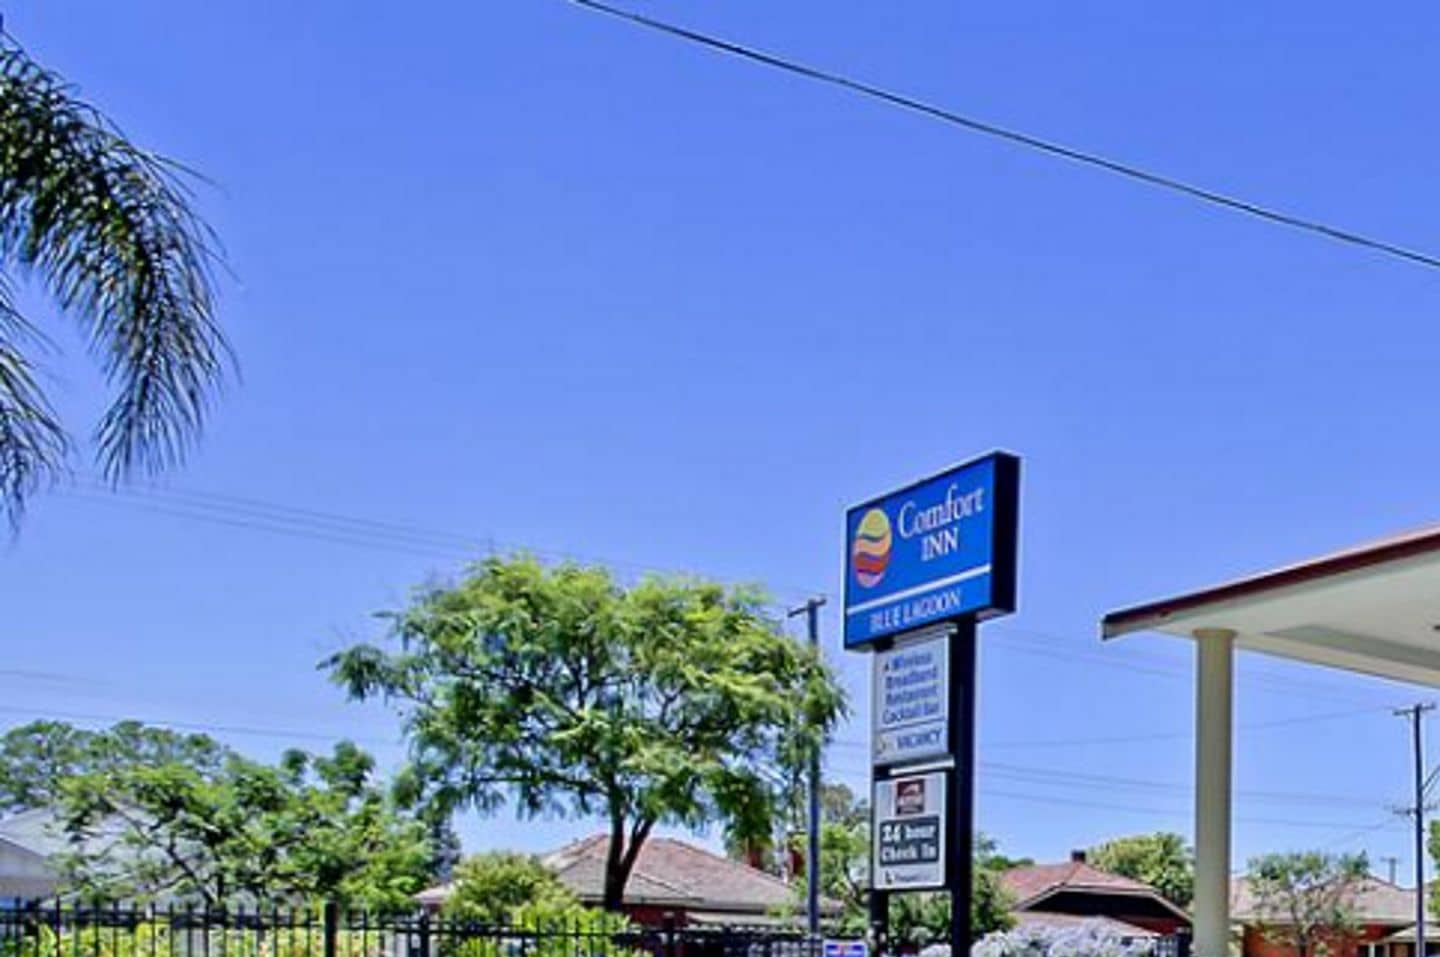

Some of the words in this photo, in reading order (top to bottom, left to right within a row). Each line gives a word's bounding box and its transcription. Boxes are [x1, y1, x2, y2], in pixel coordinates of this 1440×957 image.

[898, 484, 984, 539] Comfort
[921, 528, 960, 562] INN
[902, 586, 962, 626] LAGOON
[882, 825, 901, 841] 24
[882, 844, 919, 862] Check
[920, 843, 937, 860] In
